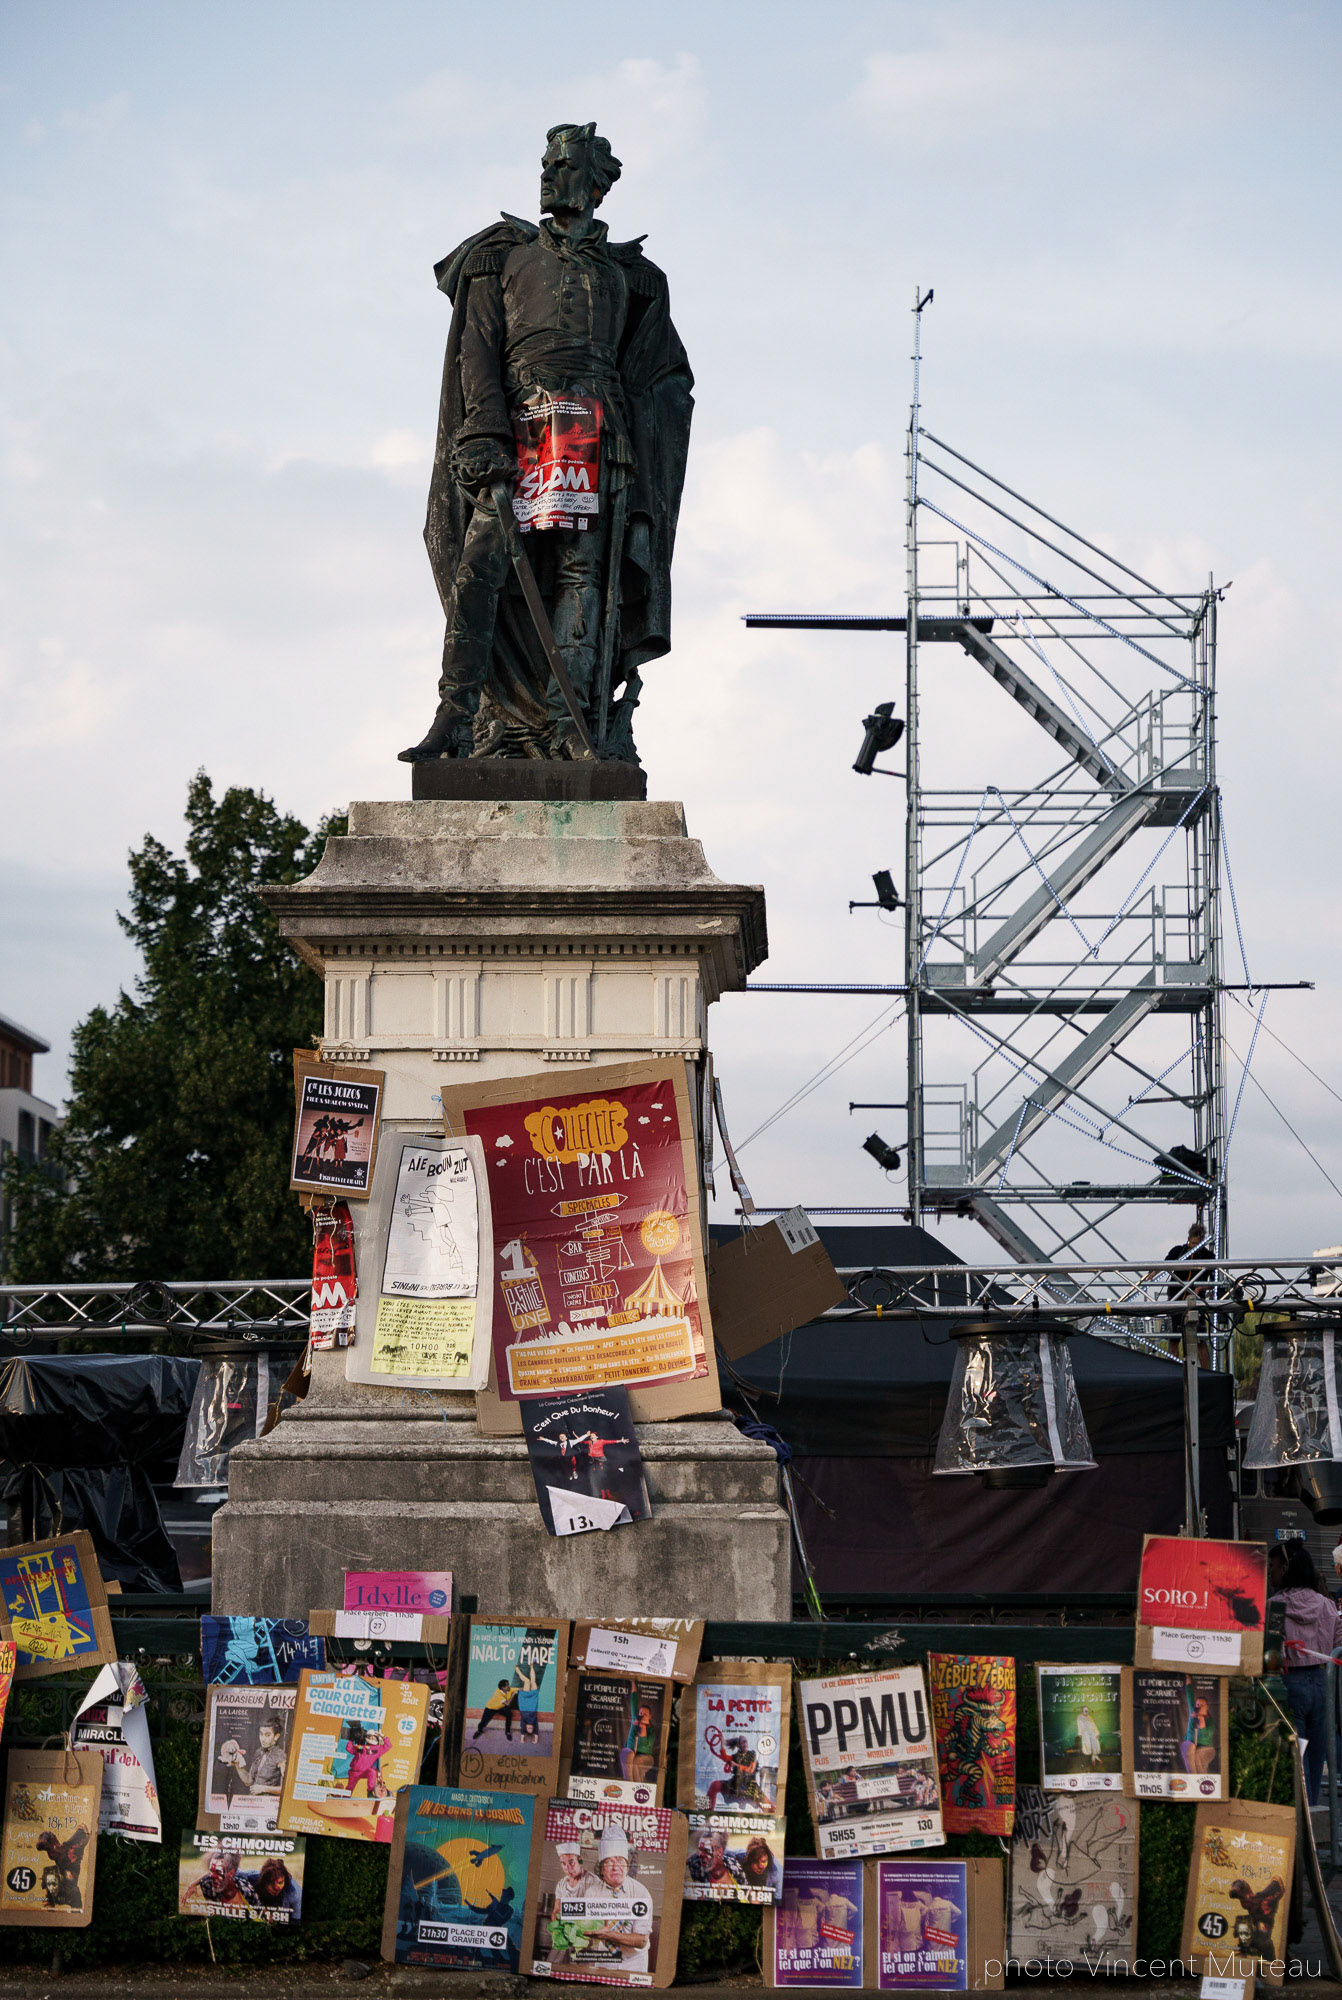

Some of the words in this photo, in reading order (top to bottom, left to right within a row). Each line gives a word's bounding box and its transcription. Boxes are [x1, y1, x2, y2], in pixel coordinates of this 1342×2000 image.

[520, 466, 591, 499] SLAM
[540, 1109, 618, 1154] COLLECTIF
[453, 1157, 469, 1175] ZUT
[525, 1155, 564, 1195] C'EST
[577, 1152, 614, 1187] PAR
[620, 1142, 645, 1180] LÀ
[567, 1196, 611, 1213] SPECTACLES
[568, 1242, 583, 1254] BAR
[563, 1268, 590, 1284] CONCERTS
[513, 1308, 549, 1329] UNE
[604, 1370, 620, 1379] PETIT
[621, 1365, 650, 1377] TONNERRE
[533, 1417, 552, 1432] C'est
[551, 1409, 570, 1420] Que
[570, 1406, 581, 1414] Du
[582, 1404, 615, 1417] Bonheur
[45, 1565, 73, 1578] STORY
[358, 1585, 422, 1611] Idylle
[1144, 1587, 1198, 1606] SORO
[613, 1635, 629, 1645] 15h
[1160, 1630, 1179, 1640] Place
[1180, 1631, 1207, 1642] Gerbert
[520, 1645, 556, 1667] MARE
[821, 1681, 829, 1689] LA
[828, 1680, 837, 1688] CIE
[857, 1677, 864, 1685] ET
[864, 1676, 874, 1684] SES
[708, 1698, 726, 1712] LA
[728, 1699, 772, 1713] PETITE
[401, 1720, 414, 1731] 15
[806, 1690, 927, 1756] PPMU
[760, 1738, 771, 1748] 10
[464, 1753, 481, 1773] 15
[497, 1754, 529, 1768] école
[814, 1756, 830, 1766] PLUS
[840, 1753, 856, 1763] PETIT
[866, 1749, 895, 1759] MOBILIER
[905, 1744, 928, 1754] URBAIN
[572, 1787, 596, 1799] 11h05
[1139, 1784, 1163, 1794] 11h05
[46, 1815, 78, 1831] 18h15
[485, 1807, 525, 1825] COSMOS
[556, 1811, 571, 1826] La
[688, 1814, 706, 1826] ES
[709, 1815, 777, 1831] CHMOUNS
[917, 1818, 933, 1831] 130
[193, 1834, 218, 1847] LES
[221, 1836, 295, 1852] CHMOUNS
[827, 1828, 856, 1842] 15H55
[11, 1868, 31, 1890] 45
[190, 1903, 246, 1919] PASTILLE
[563, 1902, 584, 1912] 9h45
[587, 1902, 608, 1910] GRAND
[608, 1902, 630, 1910] FOIRAIL
[634, 1904, 646, 1915] 12
[420, 1927, 447, 1939] 21h30
[450, 1928, 476, 1937] PLACE
[476, 1930, 488, 1938] DU
[1202, 1914, 1223, 1937] 45
[451, 1935, 486, 1945] GRAVIER
[789, 1948, 798, 1959] si
[800, 1949, 812, 1959] on
[893, 1952, 902, 1963] si
[903, 1953, 916, 1963] on
[793, 1960, 812, 1971] que
[833, 1955, 854, 1970] NEZ
[854, 1955, 861, 1967] ?
[897, 1963, 916, 1975] que
[937, 1959, 959, 1974] NEZ
[958, 1959, 965, 1971] ?
